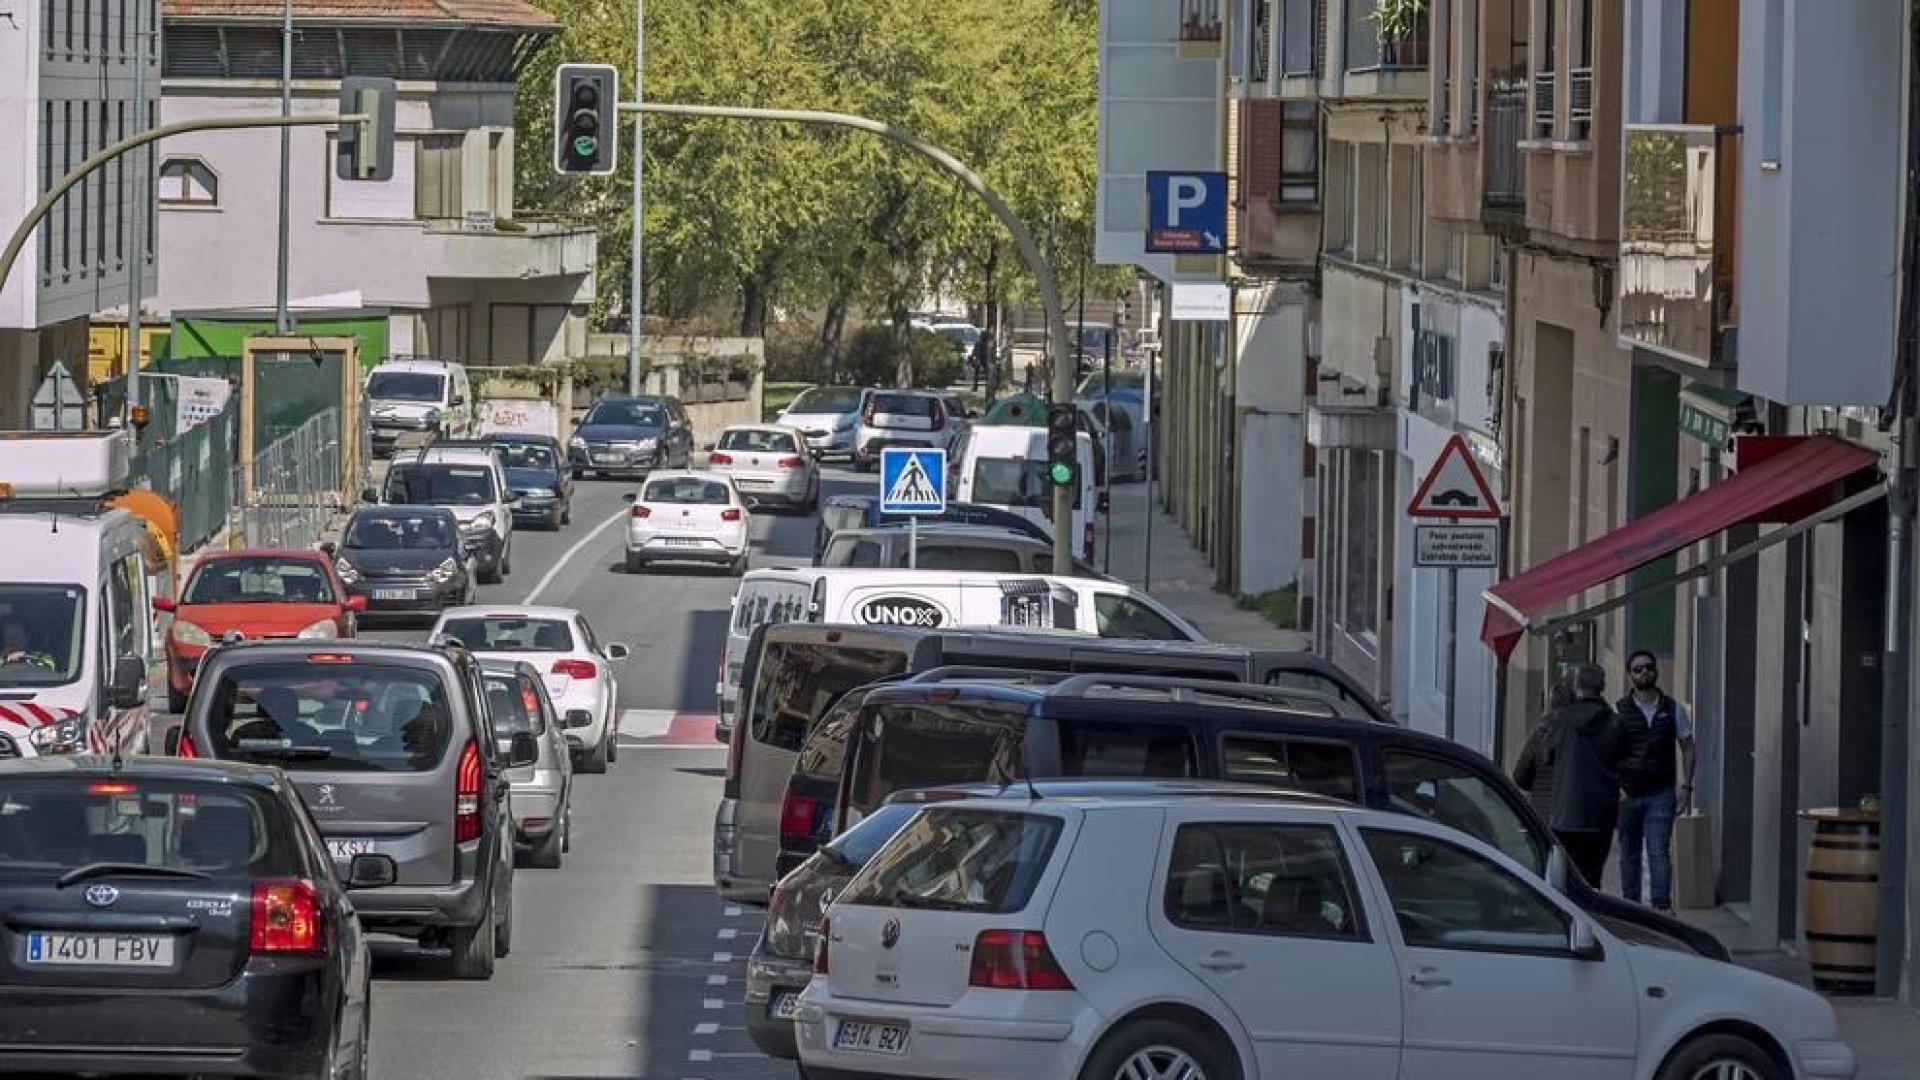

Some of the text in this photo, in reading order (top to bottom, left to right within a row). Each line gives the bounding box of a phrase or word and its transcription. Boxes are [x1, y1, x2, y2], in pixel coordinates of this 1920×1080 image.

[1167, 175, 1207, 226] P
[46, 935, 160, 961] 1401 FBV
